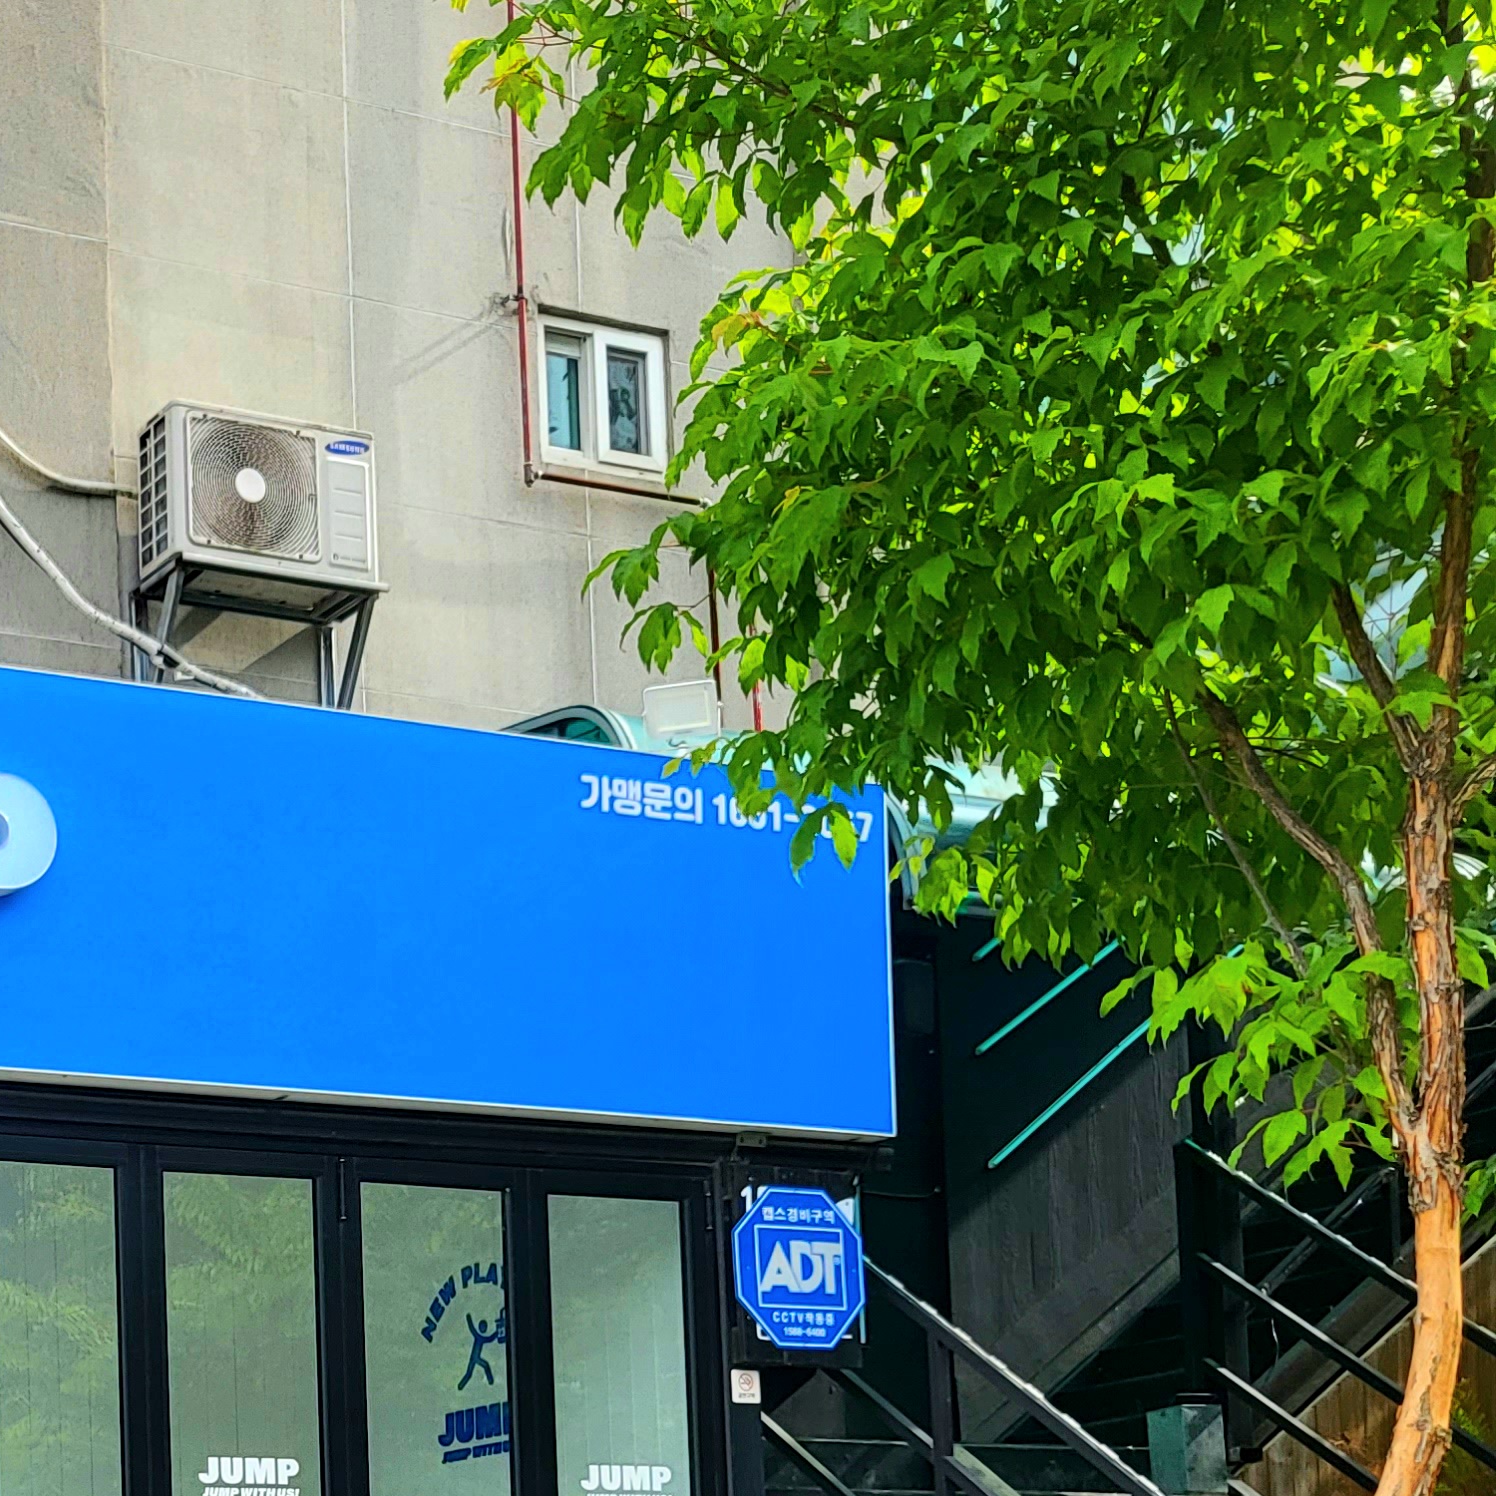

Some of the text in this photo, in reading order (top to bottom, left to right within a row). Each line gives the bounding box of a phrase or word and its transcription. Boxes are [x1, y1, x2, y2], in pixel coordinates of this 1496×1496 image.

[580, 774, 703, 824] 가맹문의
[760, 1240, 841, 1295] ADT
[198, 1457, 299, 1485] JUMP
[580, 1465, 672, 1491] JUMP
